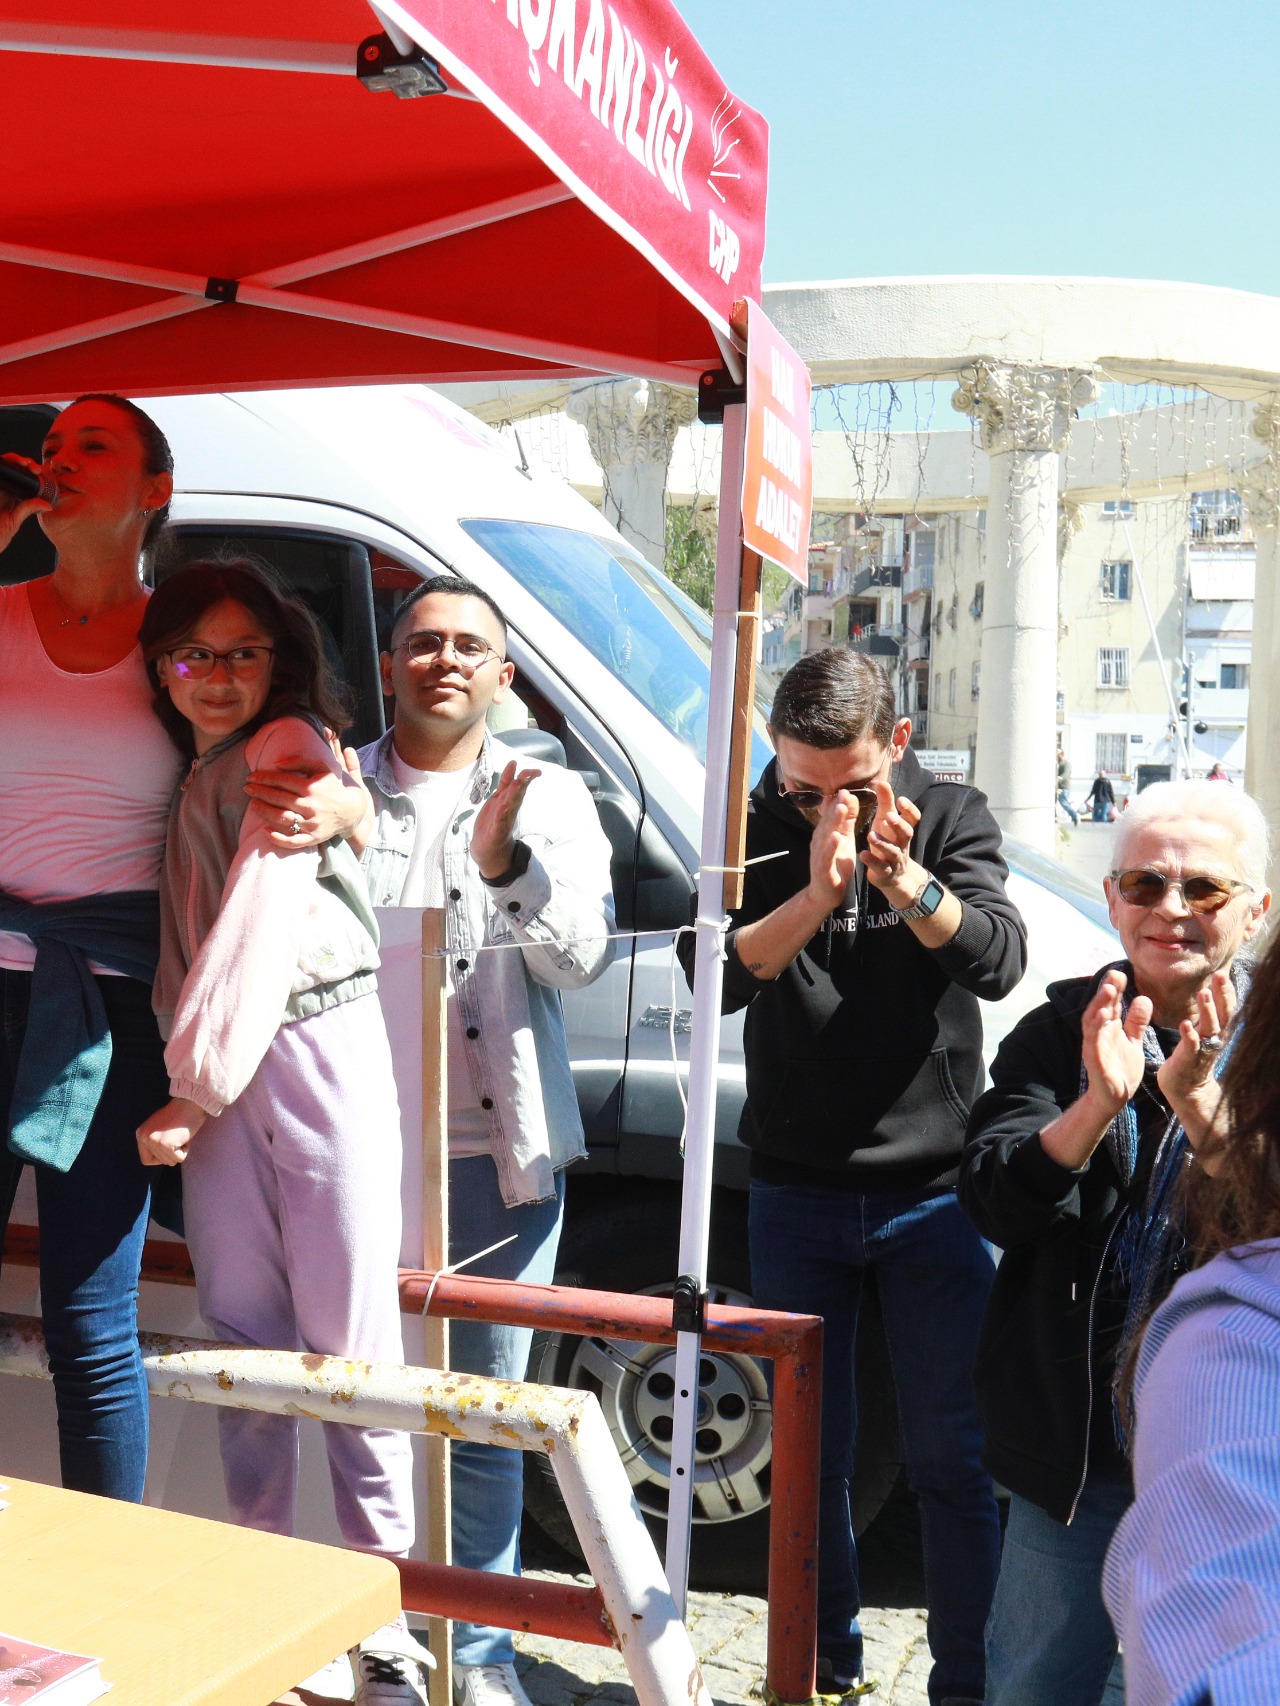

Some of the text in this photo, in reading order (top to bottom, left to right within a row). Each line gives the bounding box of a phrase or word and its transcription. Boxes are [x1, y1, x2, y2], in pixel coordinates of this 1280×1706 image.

[491, 0, 693, 212] ŞKANLIĞI
[709, 208, 741, 285] CHP
[771, 345, 797, 417] HAK
[762, 405, 803, 490] HUKUK
[756, 476, 804, 555] ADALET
[935, 773, 963, 781] rince
[820, 917, 856, 932] TONE
